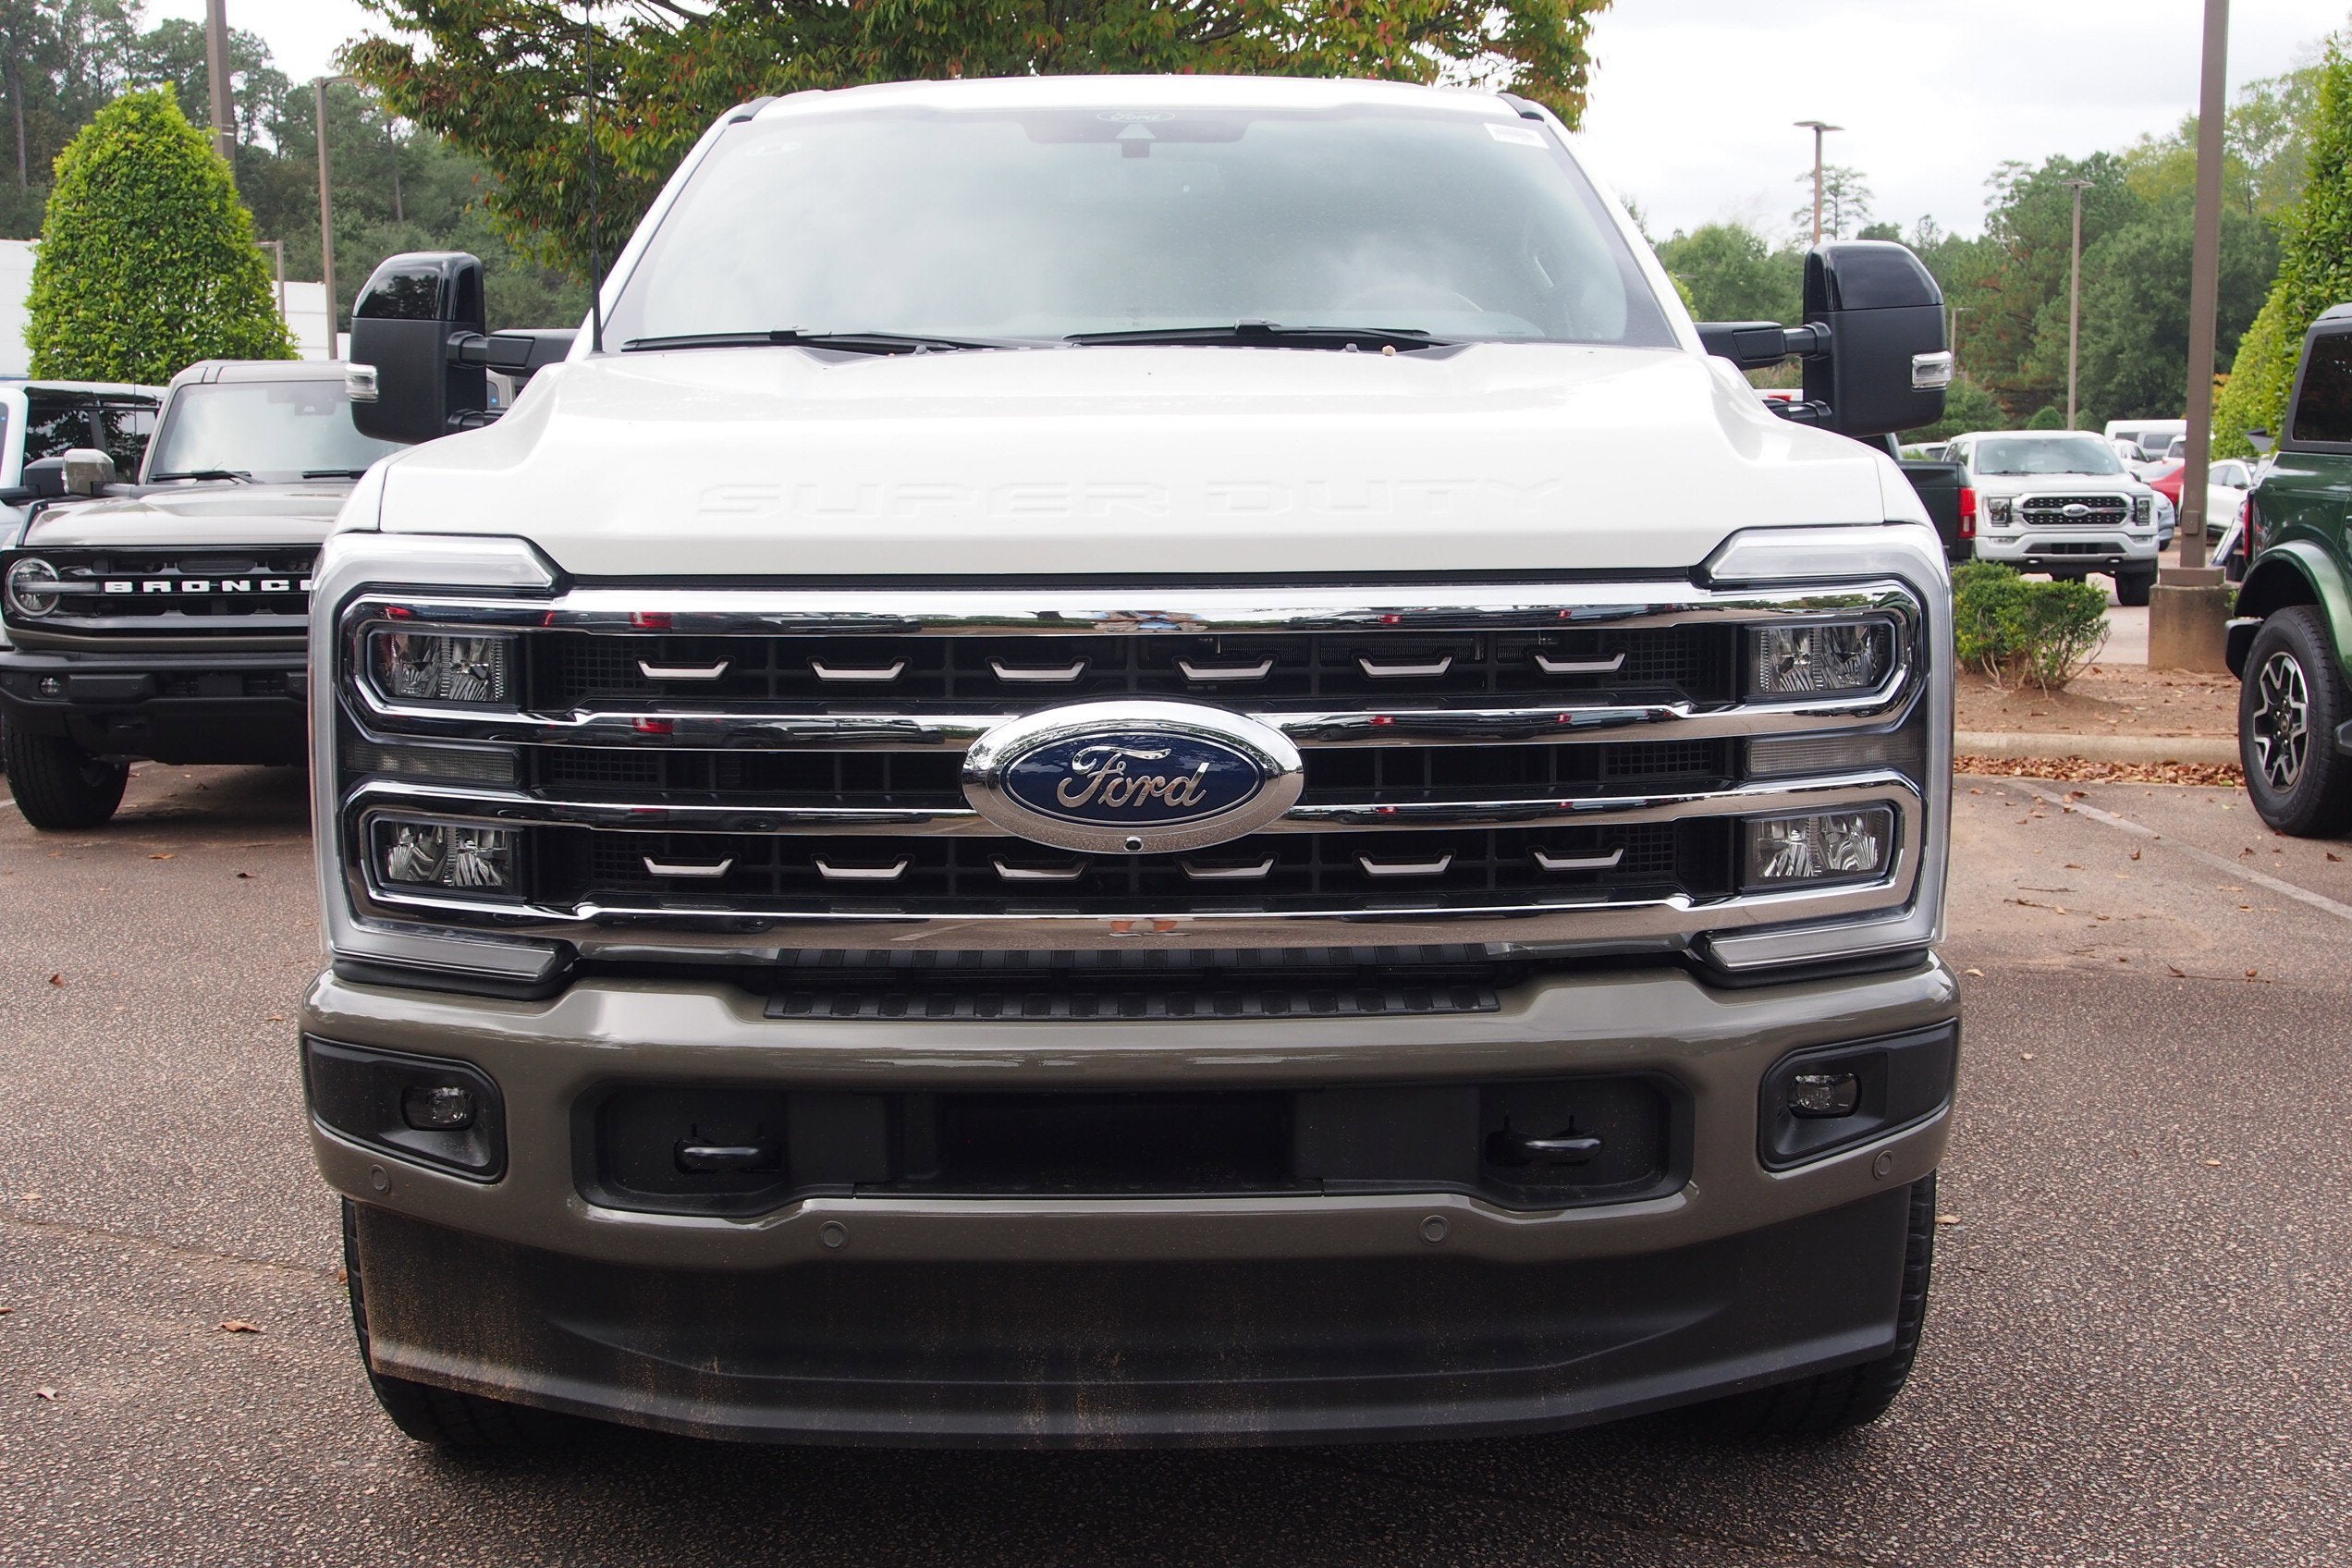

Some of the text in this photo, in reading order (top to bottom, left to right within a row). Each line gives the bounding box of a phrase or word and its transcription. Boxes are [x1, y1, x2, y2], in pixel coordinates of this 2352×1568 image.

[1109, 110, 1162, 121] Ford
[698, 477, 1562, 520] SUPER DUTY
[1056, 744, 1209, 808] Ford
